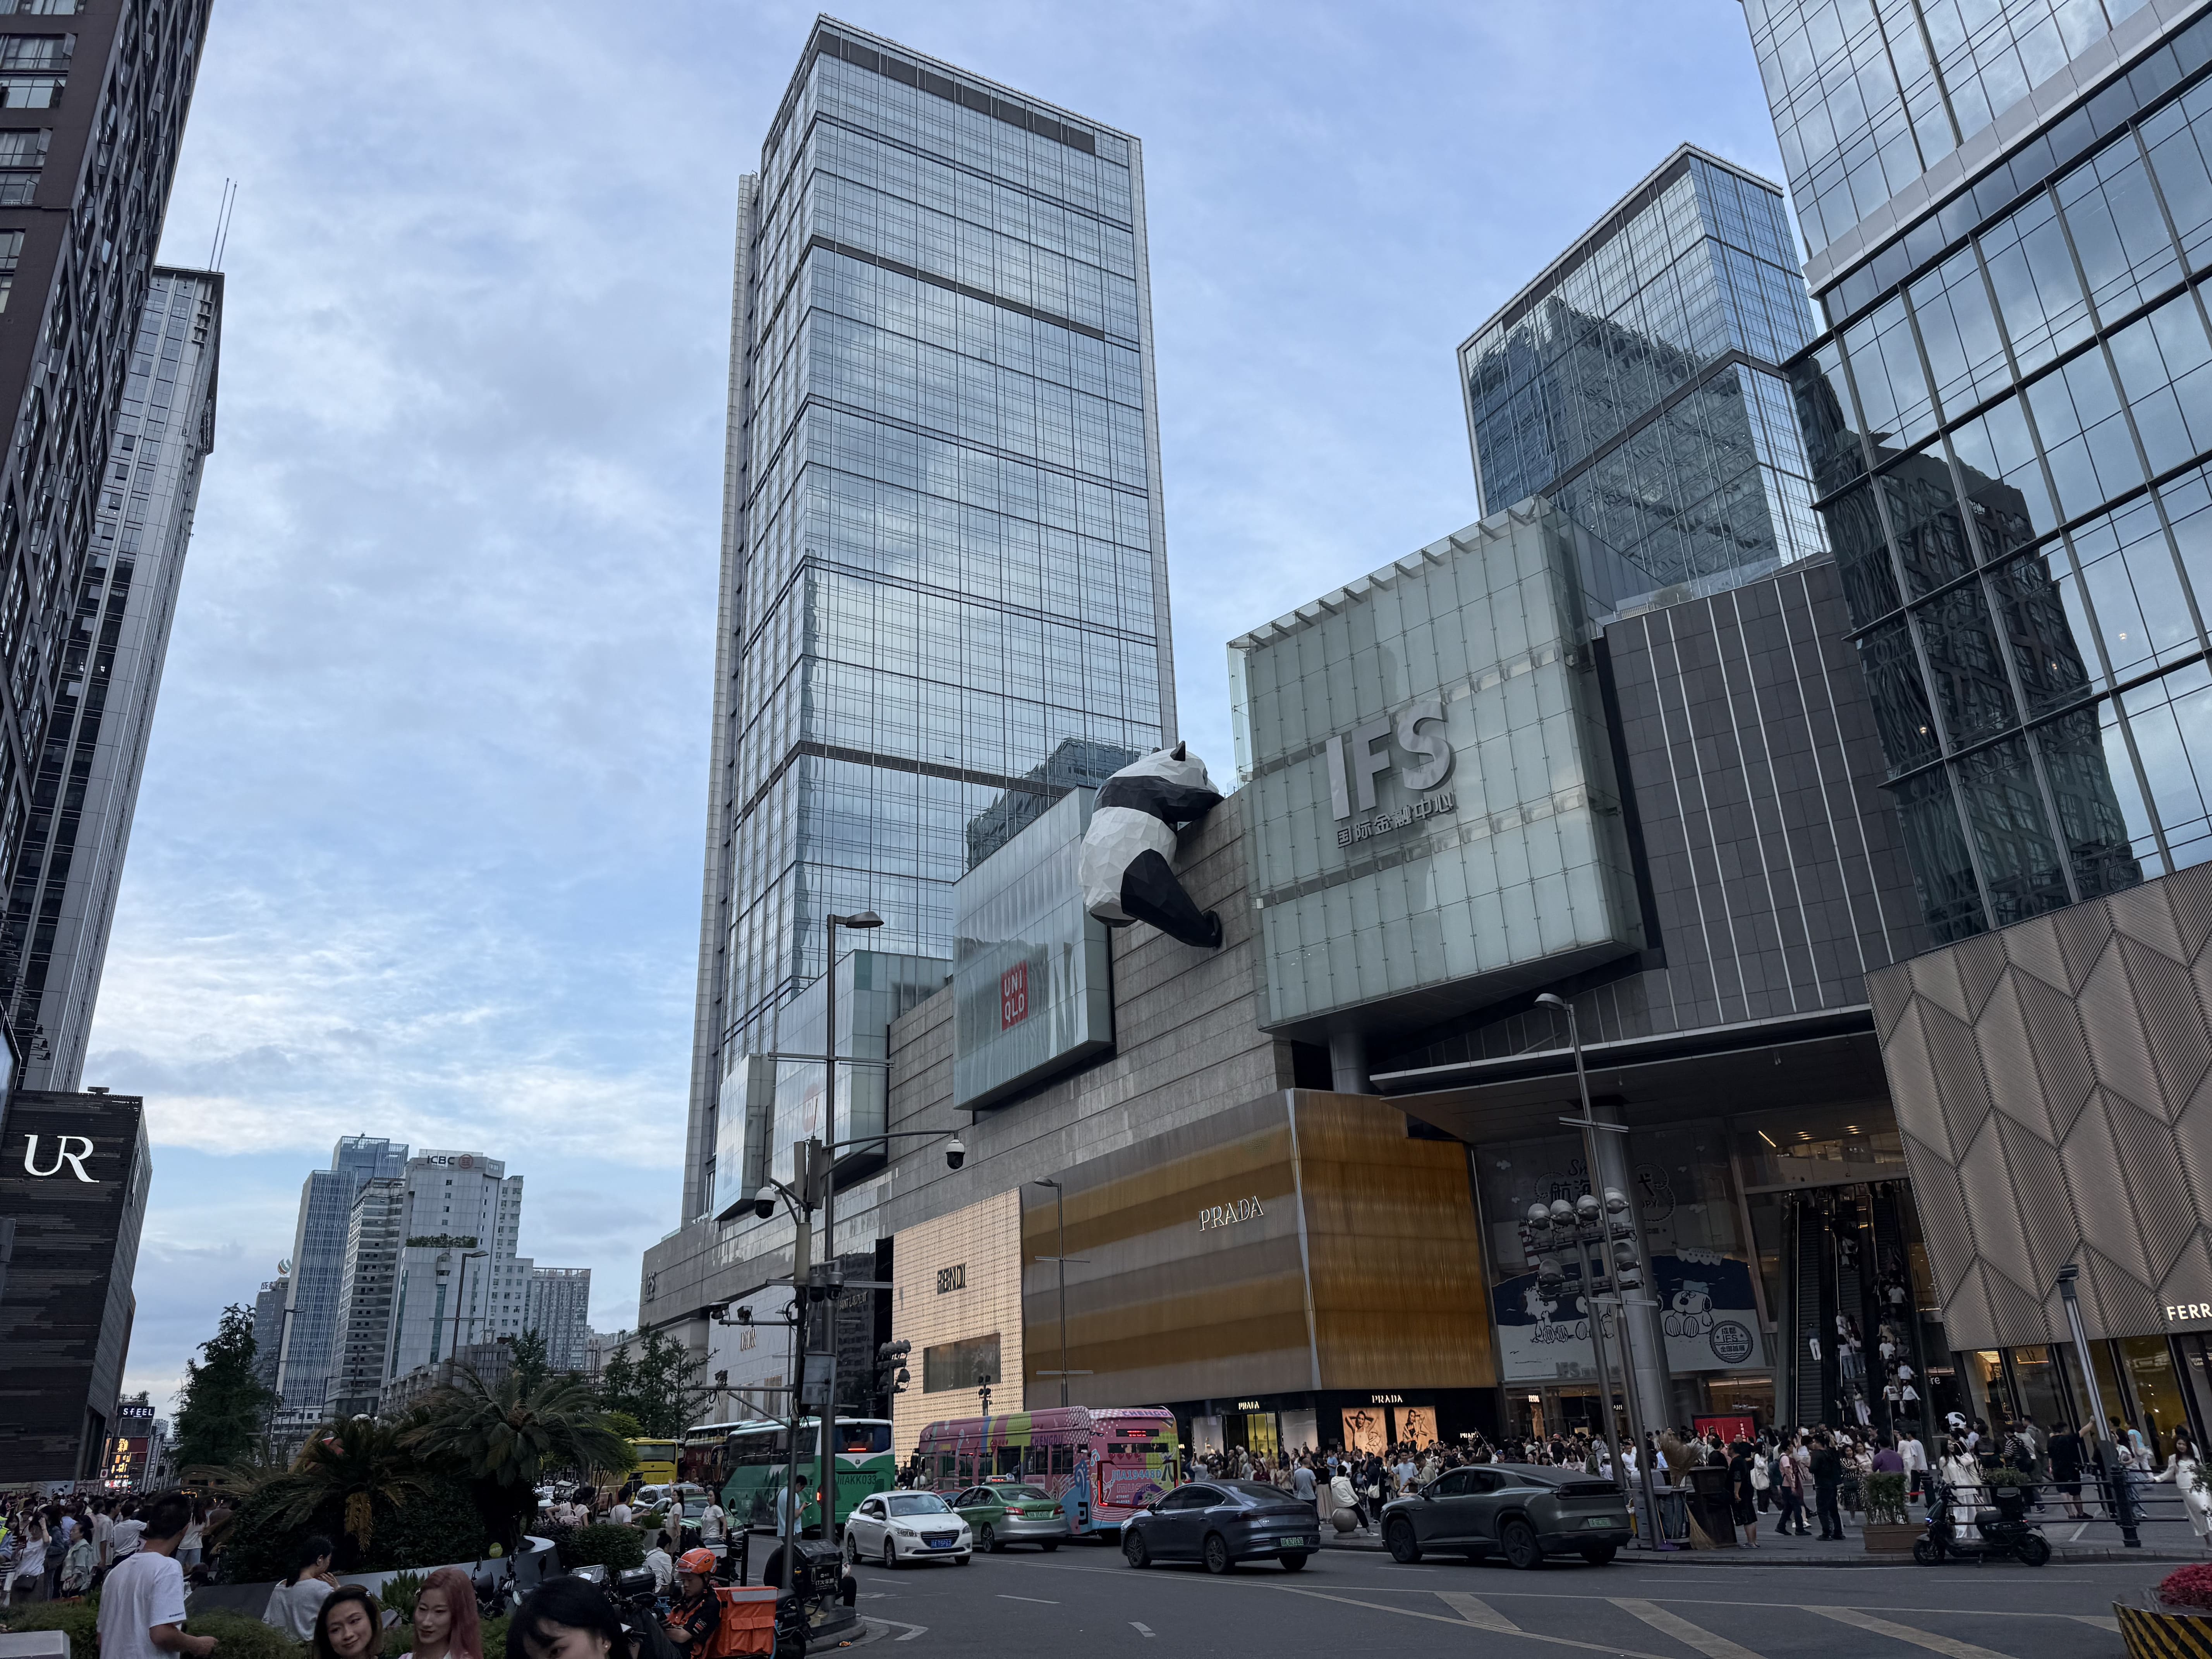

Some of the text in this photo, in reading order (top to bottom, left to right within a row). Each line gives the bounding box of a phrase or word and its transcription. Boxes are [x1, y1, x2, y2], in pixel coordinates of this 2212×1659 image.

[1326, 701, 1455, 822] IFS
[1338, 792, 1455, 848] 国际金融中心
[1004, 969, 1022, 997] UNI
[1005, 993, 1025, 1023] QLO
[24, 1134, 100, 1183] UR
[427, 1155, 455, 1165] ICBC
[1198, 1195, 1264, 1232] PRADA
[937, 1263, 967, 1295] FENDI
[740, 1328, 757, 1352] DIOR
[1372, 1394, 1403, 1403] PRADA
[837, 1475, 877, 1485] 川AKK033
